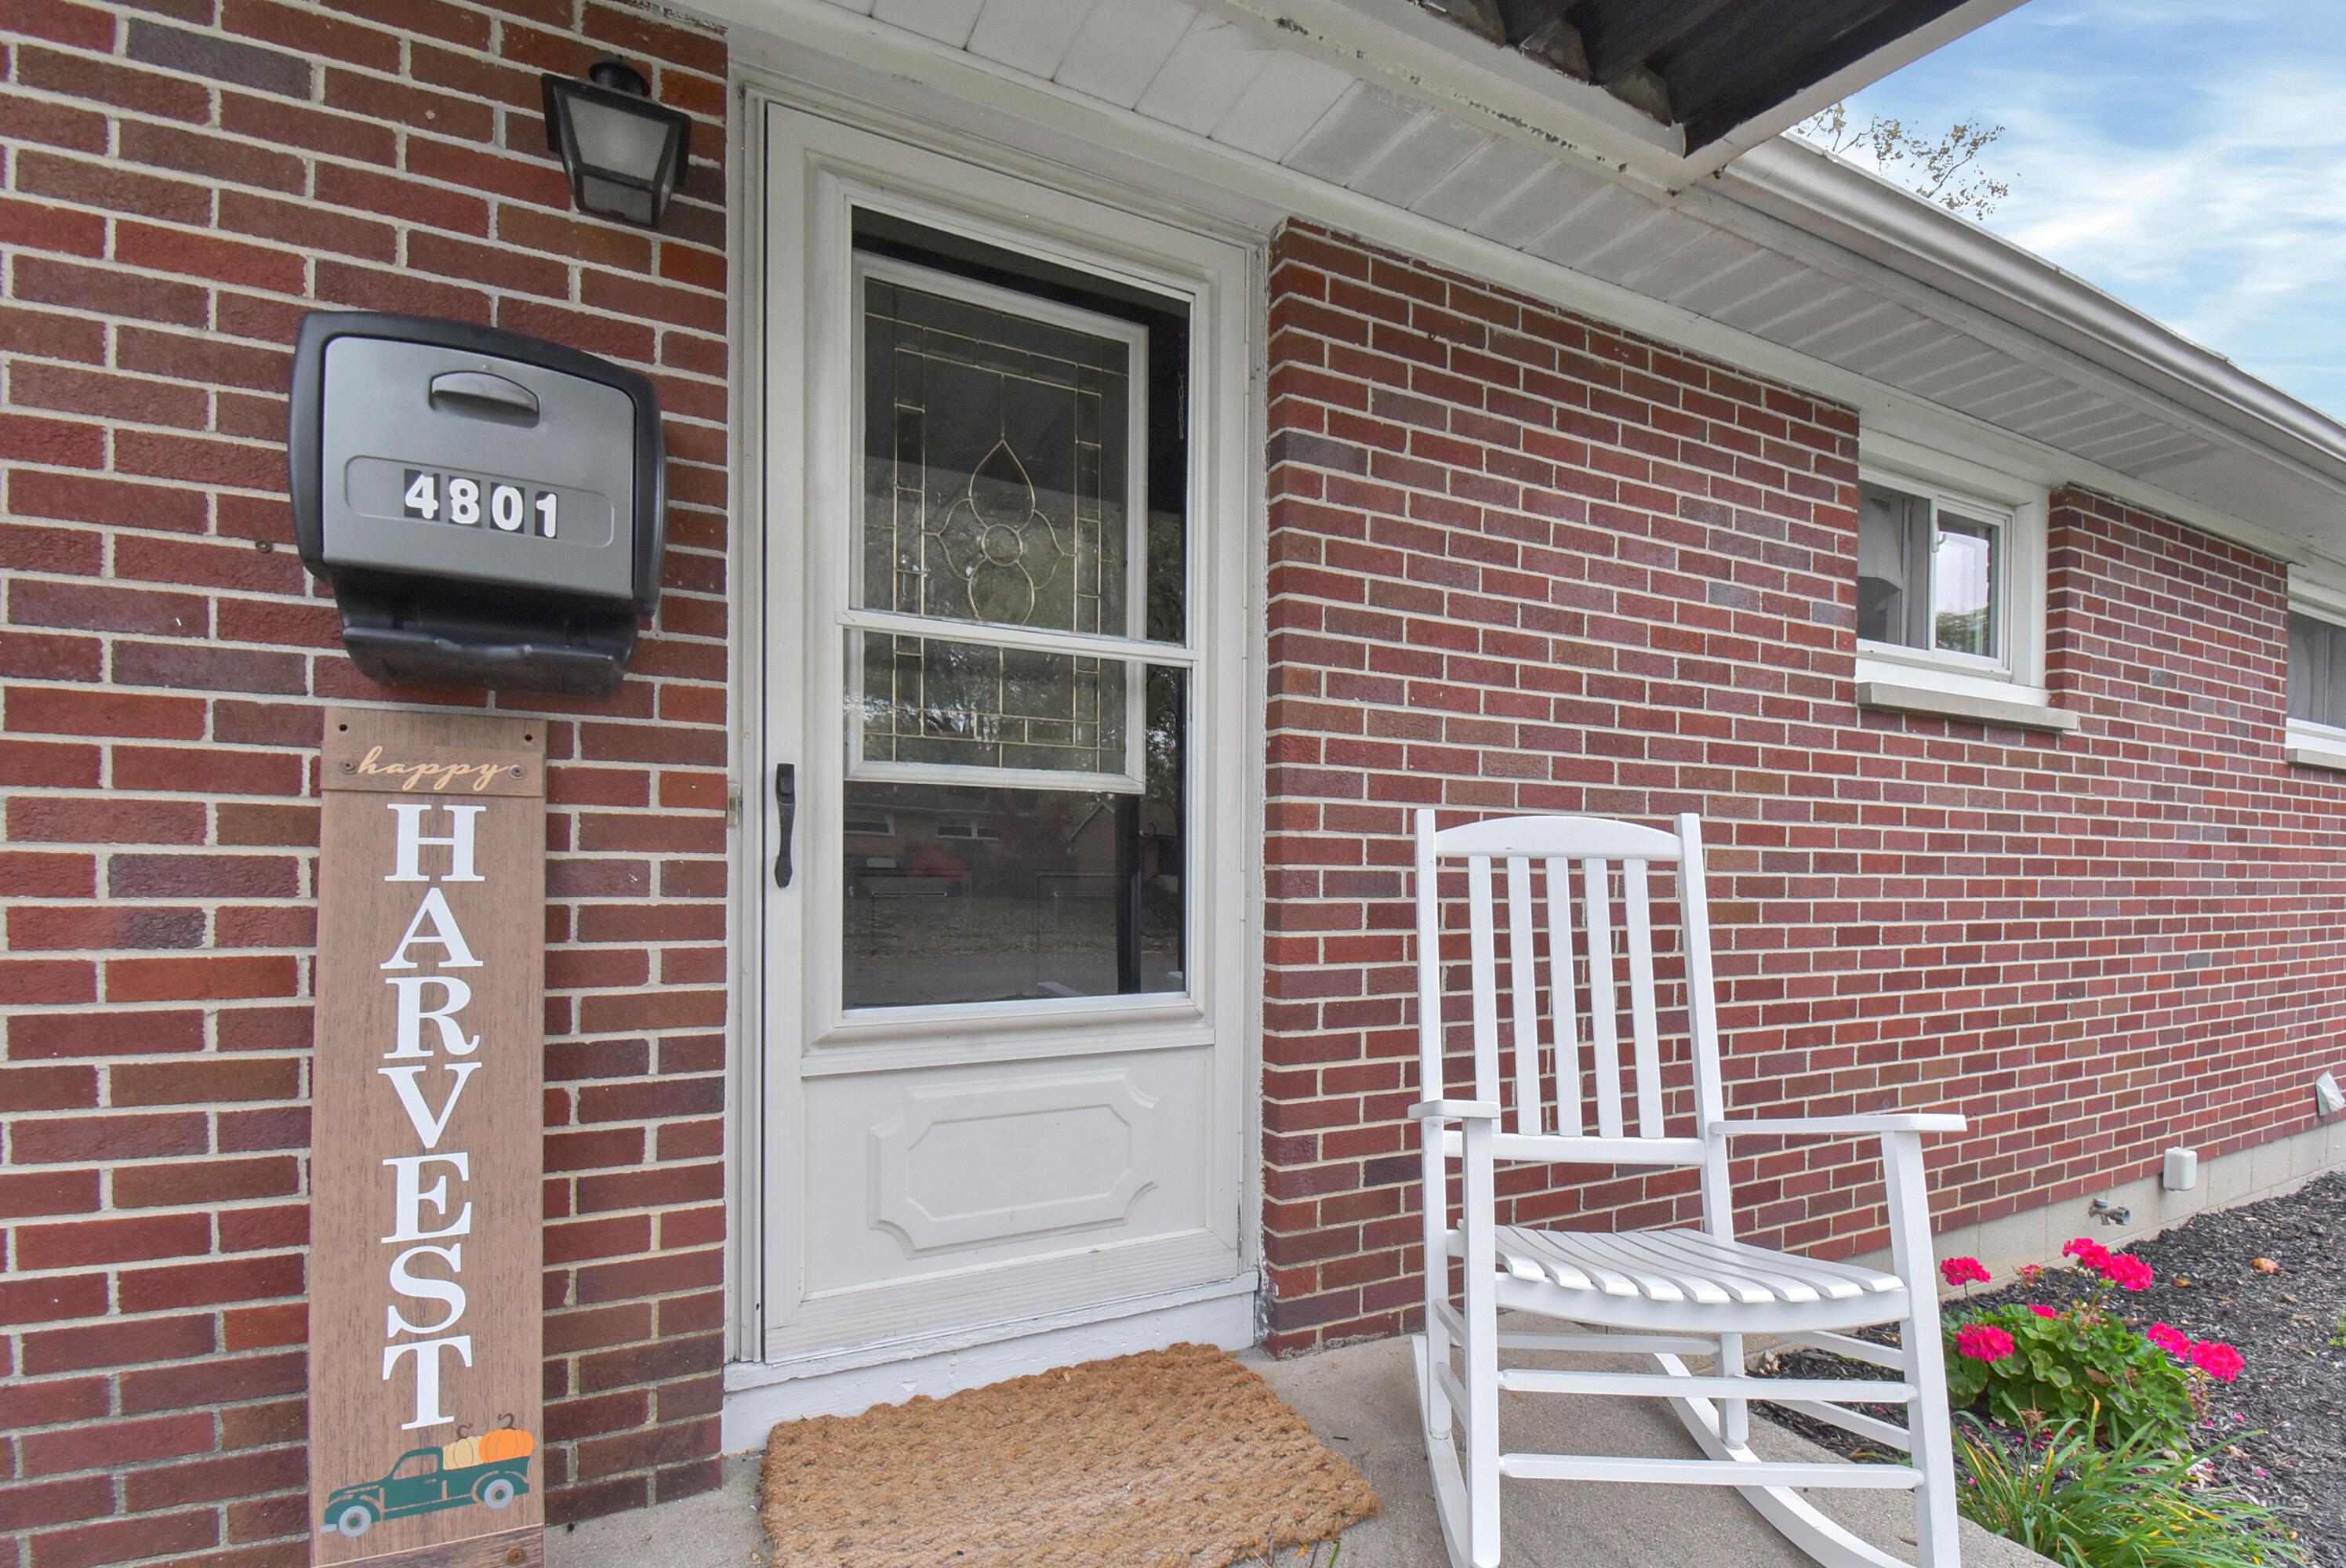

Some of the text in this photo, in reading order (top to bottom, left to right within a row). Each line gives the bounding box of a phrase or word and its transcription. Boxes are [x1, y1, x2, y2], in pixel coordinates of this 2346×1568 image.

[404, 473, 557, 539] 4801
[358, 746, 510, 791] happy
[377, 804, 487, 1430] HARVEST
